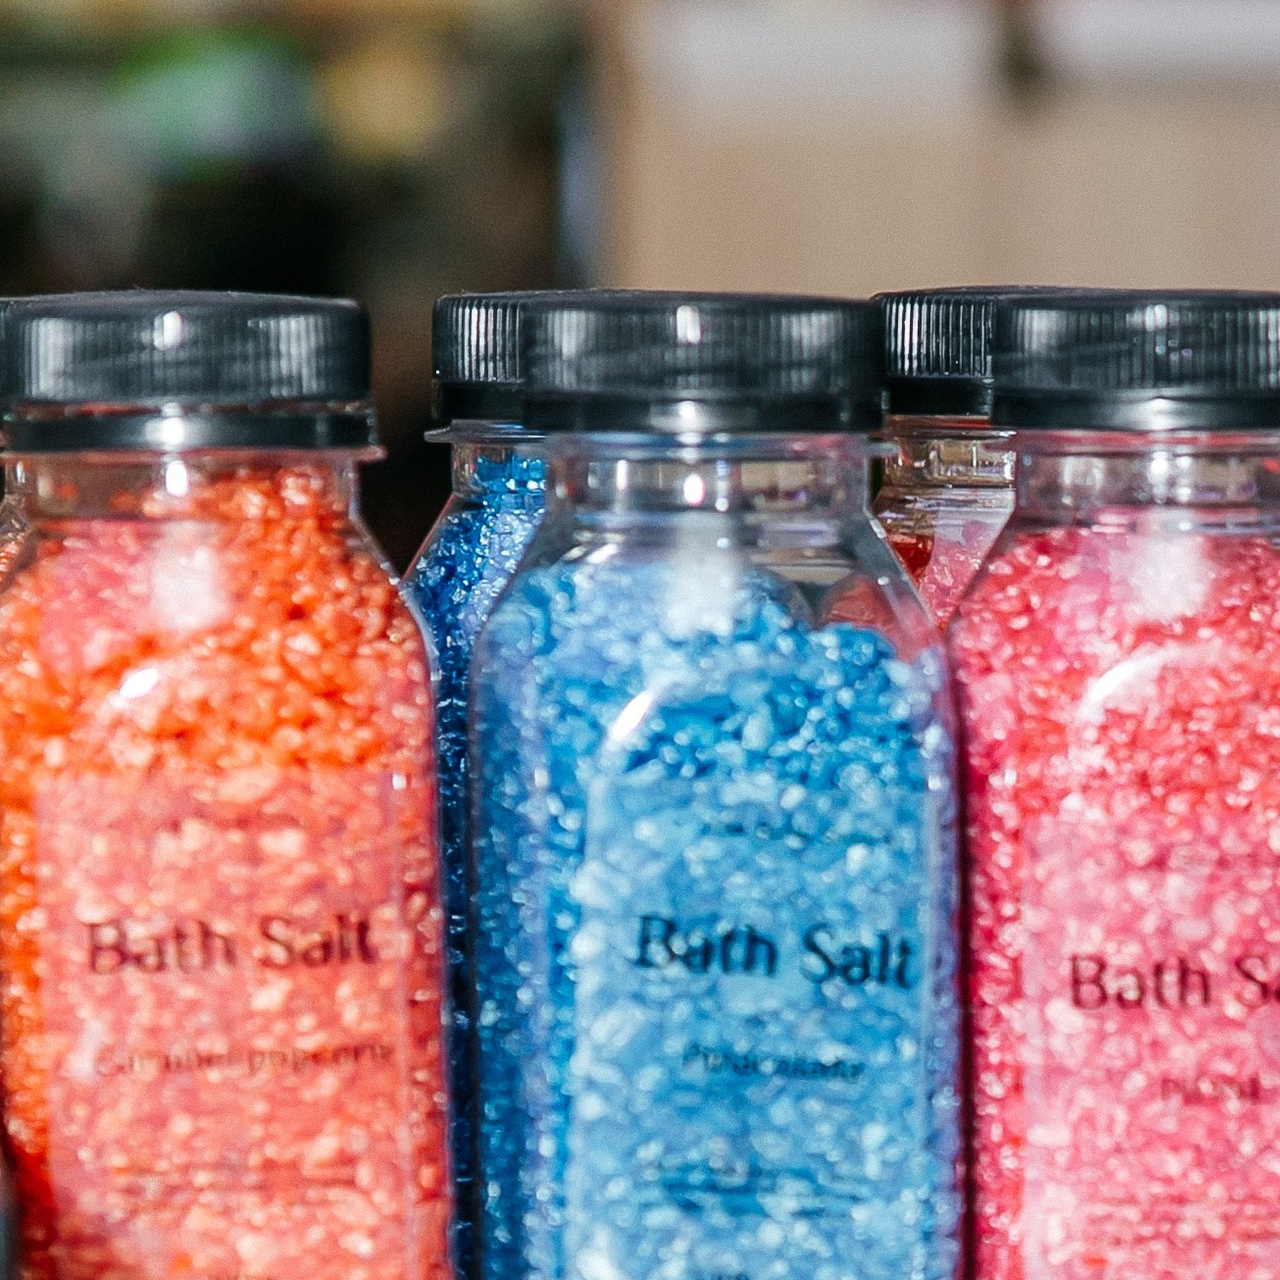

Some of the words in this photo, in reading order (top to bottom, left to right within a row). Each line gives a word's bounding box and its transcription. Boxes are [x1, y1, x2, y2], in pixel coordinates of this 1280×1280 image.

[86, 919, 239, 975] Bath
[258, 912, 379, 970] Salt
[635, 914, 779, 978] Bath
[801, 920, 917, 990] Salt
[1069, 952, 1213, 1010] Bath
